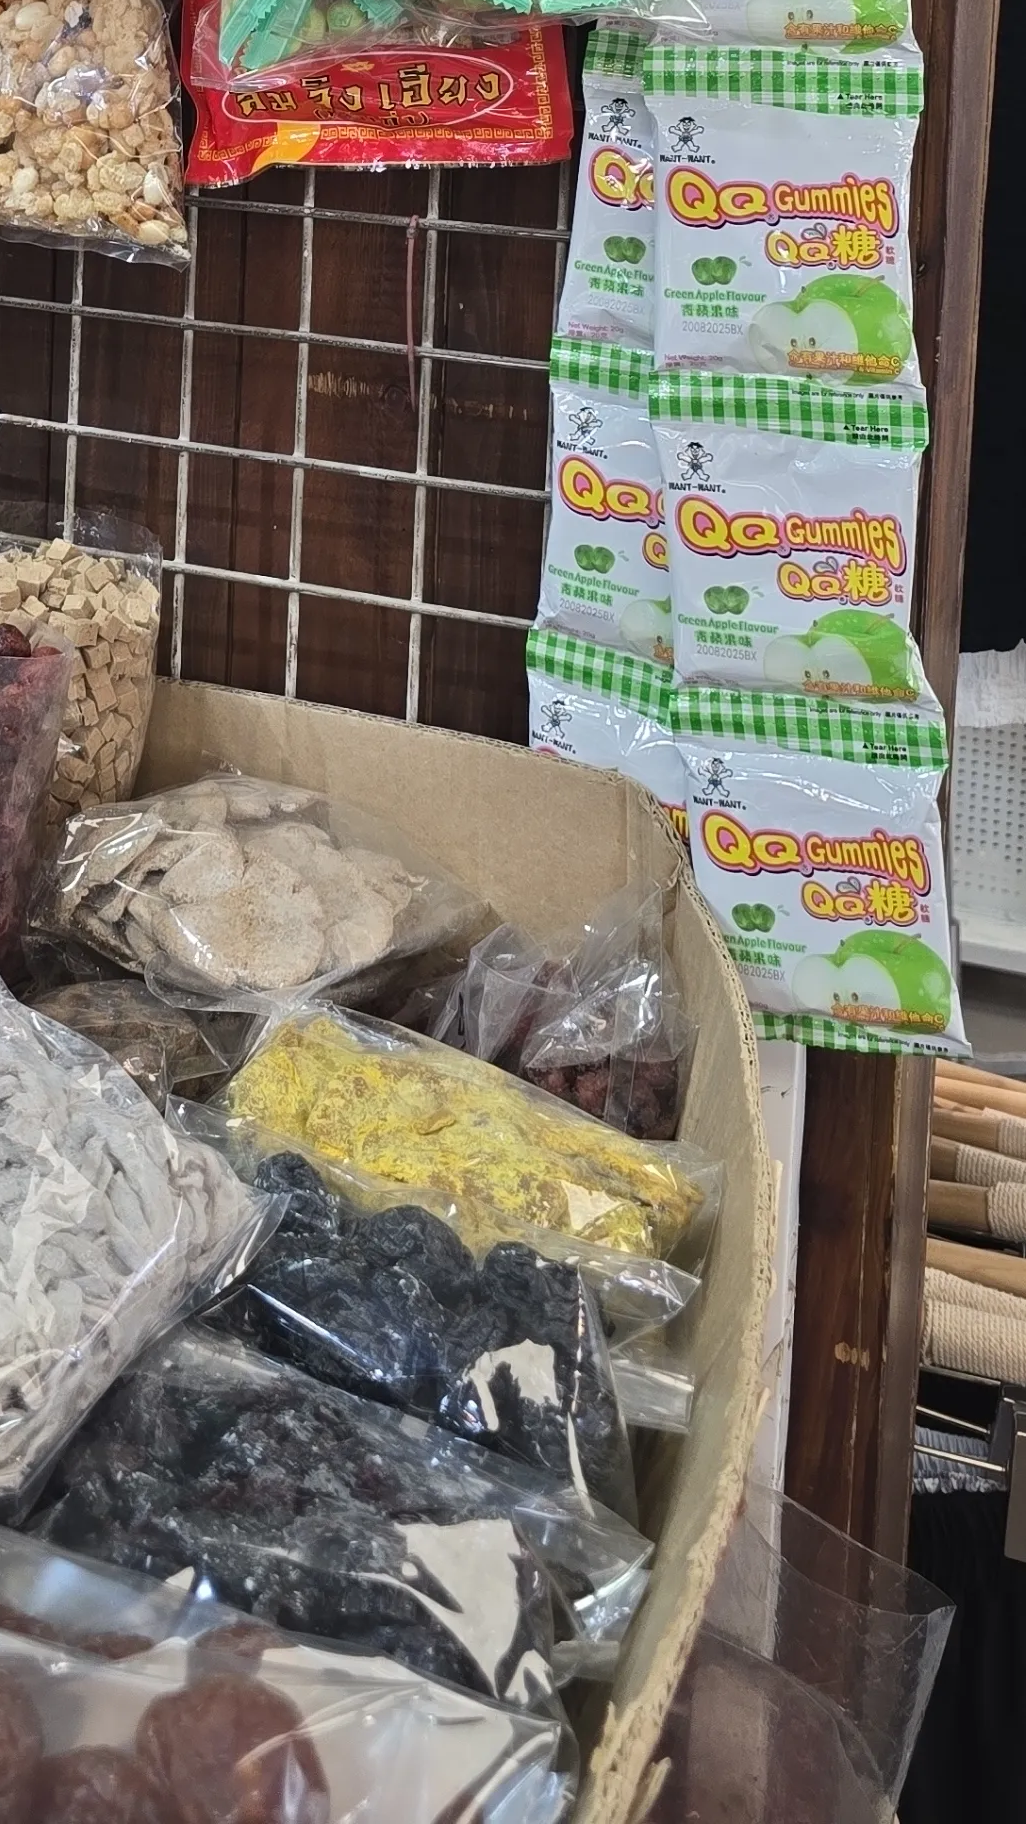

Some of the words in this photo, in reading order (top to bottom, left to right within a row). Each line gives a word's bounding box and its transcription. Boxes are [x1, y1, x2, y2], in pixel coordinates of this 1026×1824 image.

[668, 168, 769, 222] QQ
[773, 173, 894, 233] Gummies
[765, 223, 882, 266] QQ糖
[574, 260, 604, 273] Green
[604, 264, 633, 280] Apple
[634, 269, 655, 282] Flav
[664, 288, 694, 299] Green
[695, 289, 725, 302] Apple
[726, 290, 767, 302] Flavour
[682, 321, 744, 335] 20082025BX
[851, 424, 868, 432] Tear
[557, 439, 604, 458] WANT-WANT
[559, 457, 652, 517] QQ
[669, 482, 722, 493] WANT-WANT
[677, 496, 782, 553] QQ
[785, 509, 902, 570] Gummies
[548, 564, 575, 580] Green
[574, 572, 602, 589] Apple
[602, 579, 641, 597] Flavour
[777, 558, 890, 603] QQ糖
[559, 598, 615, 623] 20082025BX
[677, 614, 707, 627] Green
[708, 617, 738, 631] Apple
[738, 620, 779, 634] Flavour
[696, 643, 757, 661] 20082025BX
[693, 795, 741, 810] WANT-WANT
[702, 811, 803, 870] QQ
[806, 829, 926, 892] Gummies
[802, 879, 916, 925] QQ糖
[737, 935, 766, 948] Apple
[767, 938, 807, 953] Flavour
[737, 964, 786, 981] 082025BX
